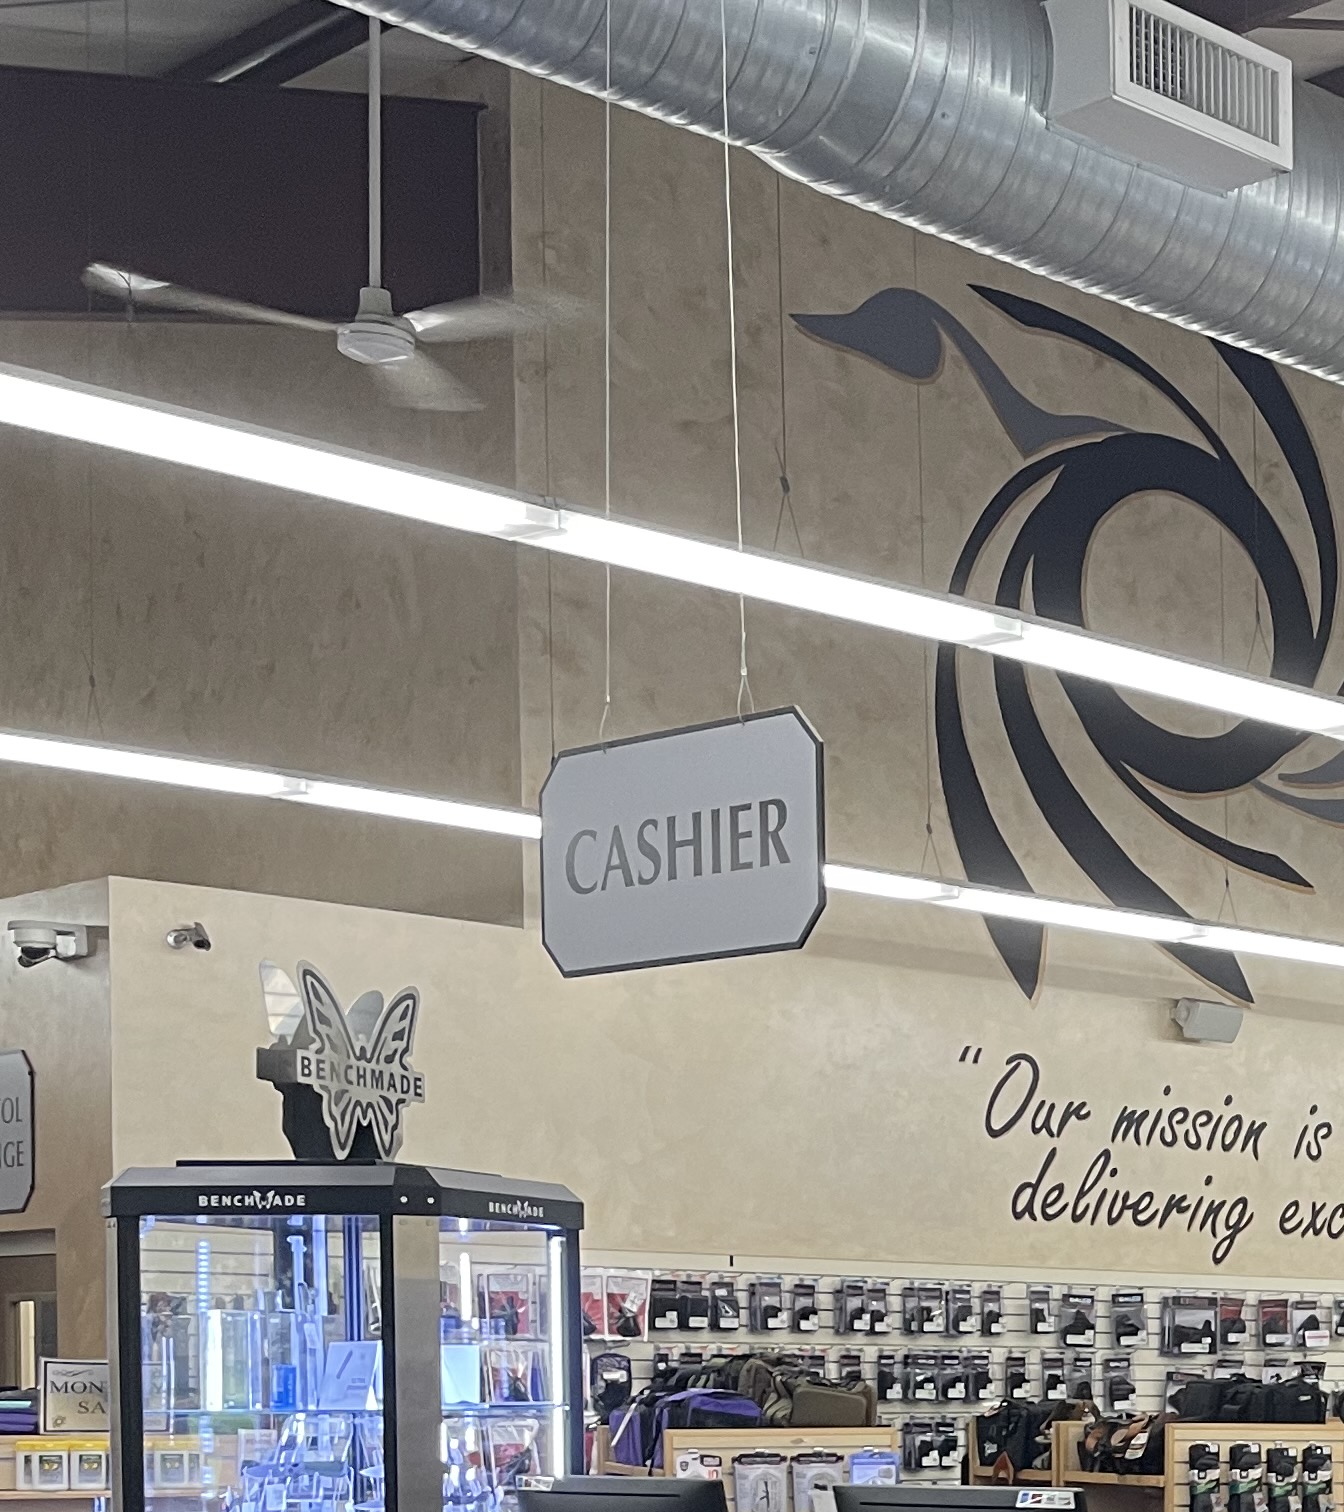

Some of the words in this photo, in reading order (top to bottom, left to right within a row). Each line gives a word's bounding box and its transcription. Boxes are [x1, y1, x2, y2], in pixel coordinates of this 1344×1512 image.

[566, 798, 791, 896] CASHIER
[300, 1055, 424, 1098] BENCHMADE
[1111, 1085, 1267, 1160] mission
[1295, 1104, 1333, 1163] is
[1011, 1147, 1254, 1265] delivering
